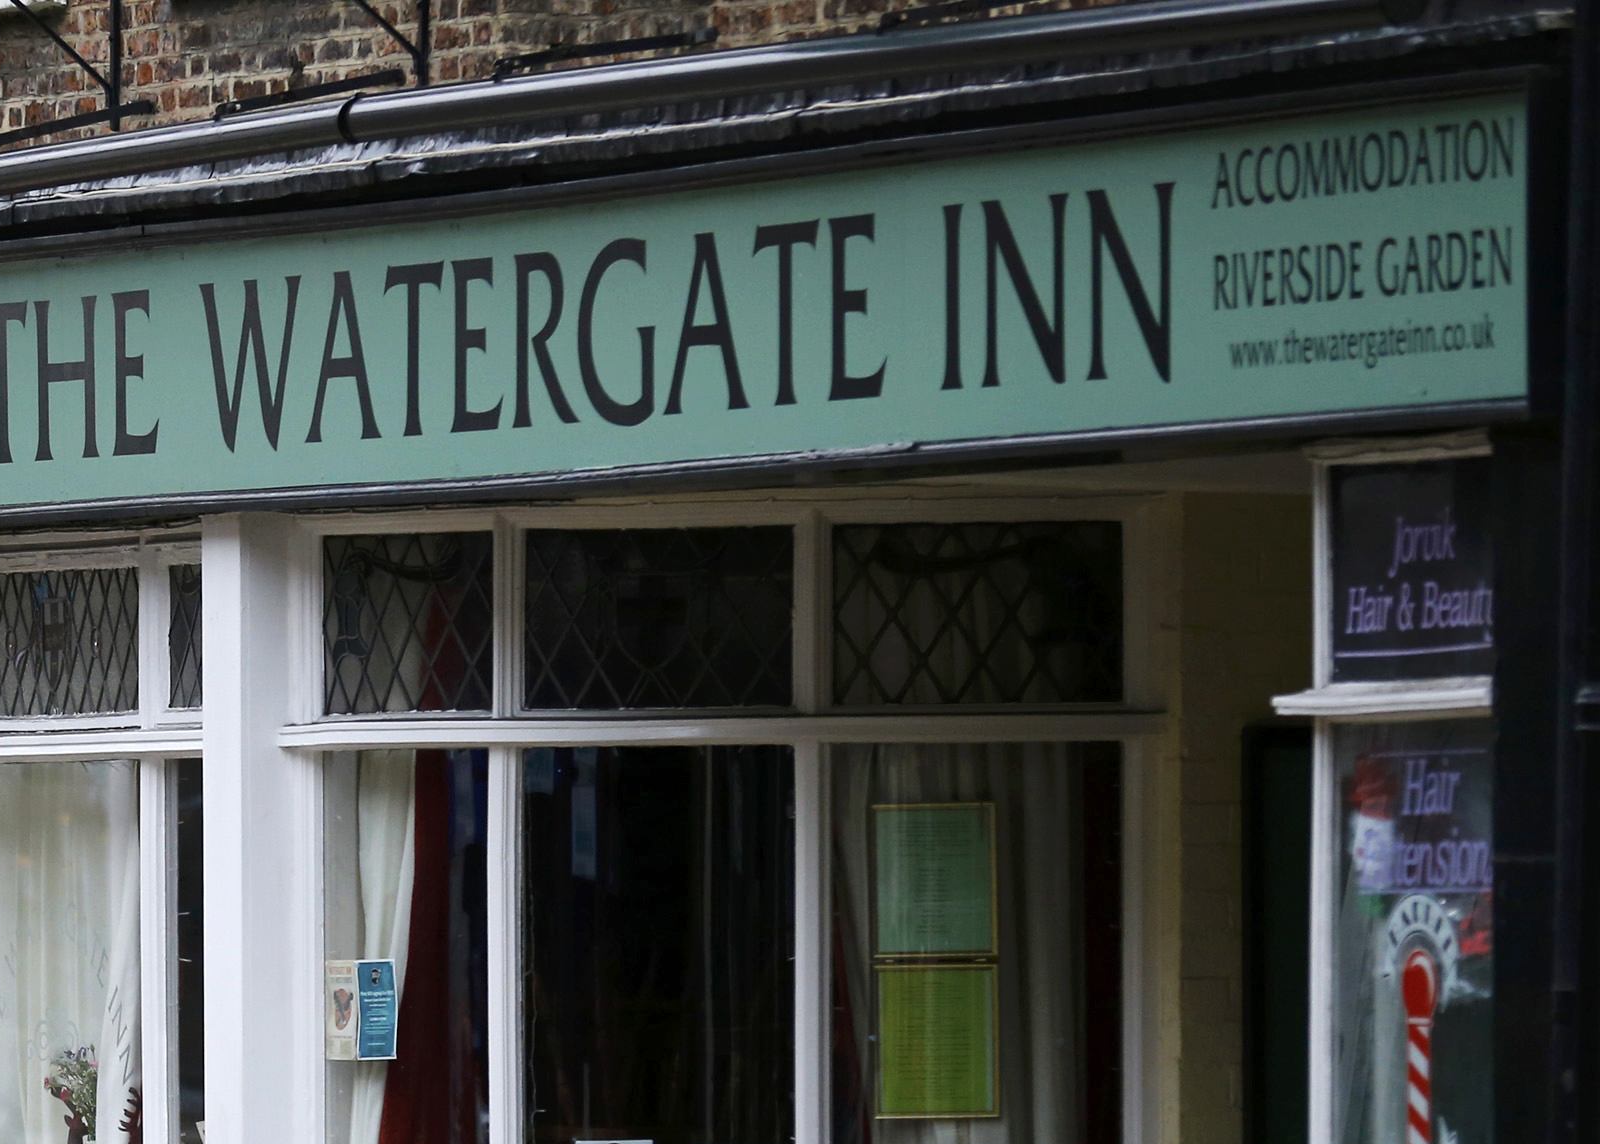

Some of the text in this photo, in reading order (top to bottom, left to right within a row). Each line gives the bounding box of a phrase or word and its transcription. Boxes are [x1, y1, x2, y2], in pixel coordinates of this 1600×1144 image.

[1211, 116, 1515, 209] ACCOMMODATION
[1213, 226, 1513, 311] RIVERSIDE GARDEN
[199, 212, 889, 453] WATERGATE
[941, 180, 1177, 392] INN
[1229, 313, 1495, 369] www.thewatergateinn.co.uk
[1345, 584, 1393, 634] Hair
[1398, 581, 1416, 632] &
[1402, 757, 1461, 816] Hair
